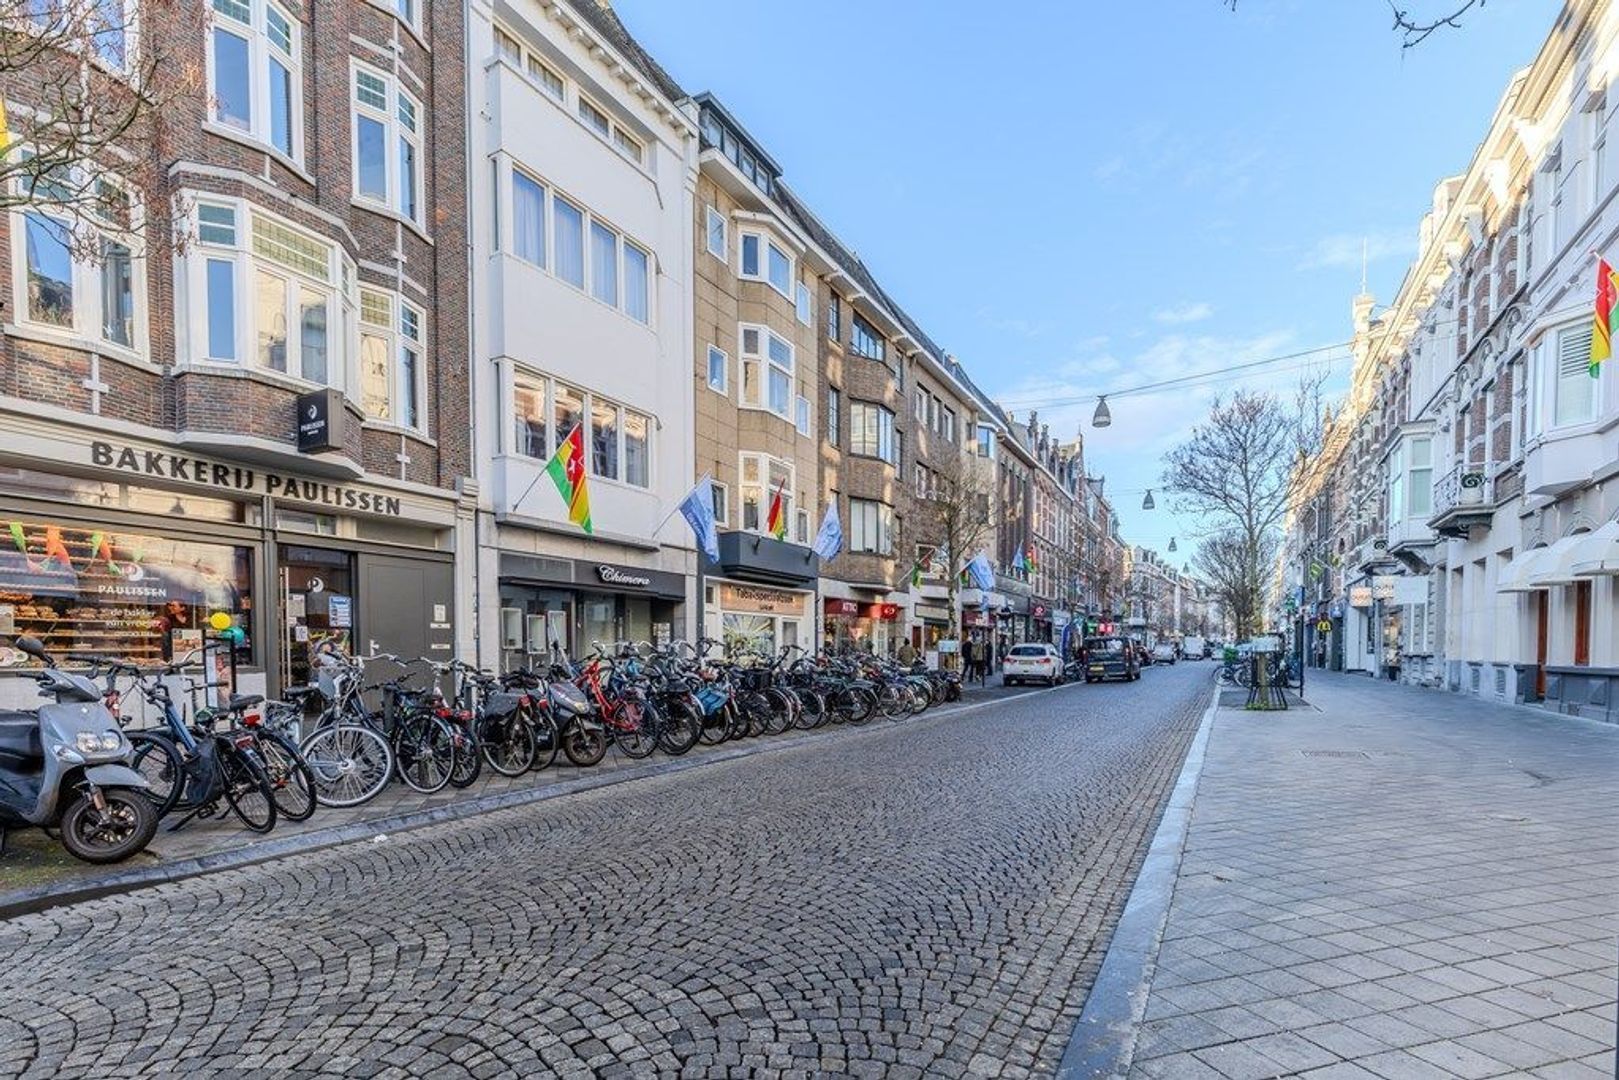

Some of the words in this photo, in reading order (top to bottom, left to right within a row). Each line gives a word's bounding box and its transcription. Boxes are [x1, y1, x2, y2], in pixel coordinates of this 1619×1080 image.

[91, 441, 254, 490] BAKKERIJ
[266, 474, 400, 515] PAULISSEN
[98, 585, 167, 597] PAULISSEN
